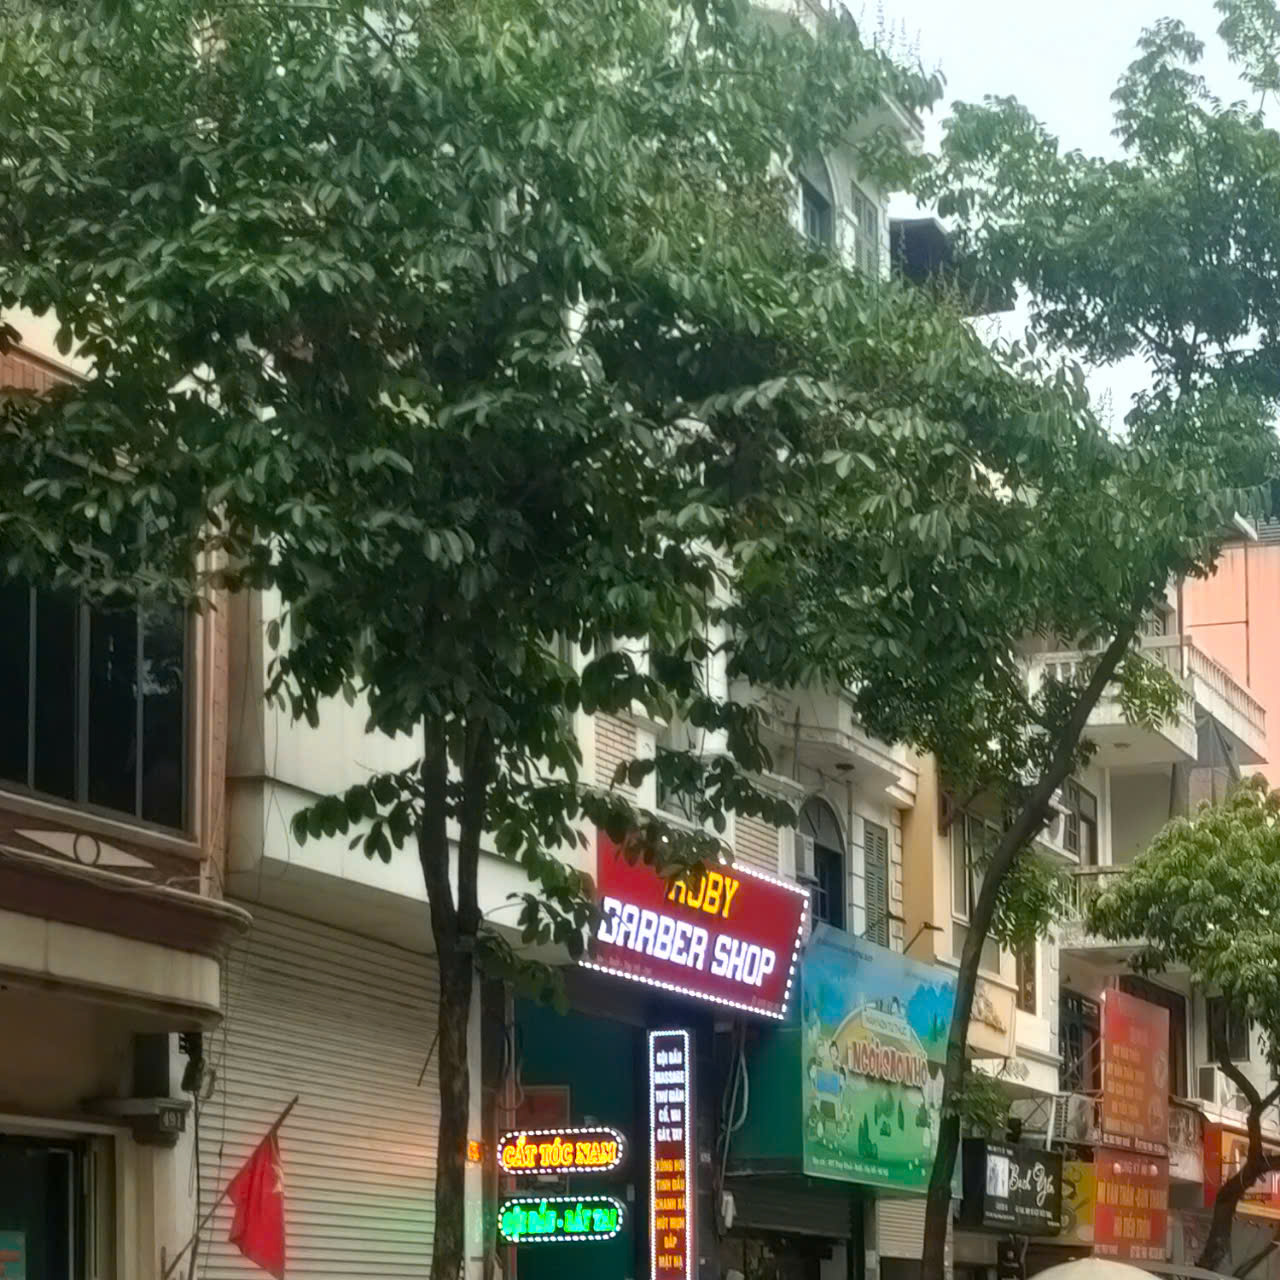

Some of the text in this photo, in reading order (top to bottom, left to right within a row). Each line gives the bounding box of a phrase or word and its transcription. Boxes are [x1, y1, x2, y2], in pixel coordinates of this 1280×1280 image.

[597, 896, 776, 987] BARBER SHOP
[163, 1111, 182, 1129] 491
[502, 1135, 617, 1168] CẮT TÓC NAM
